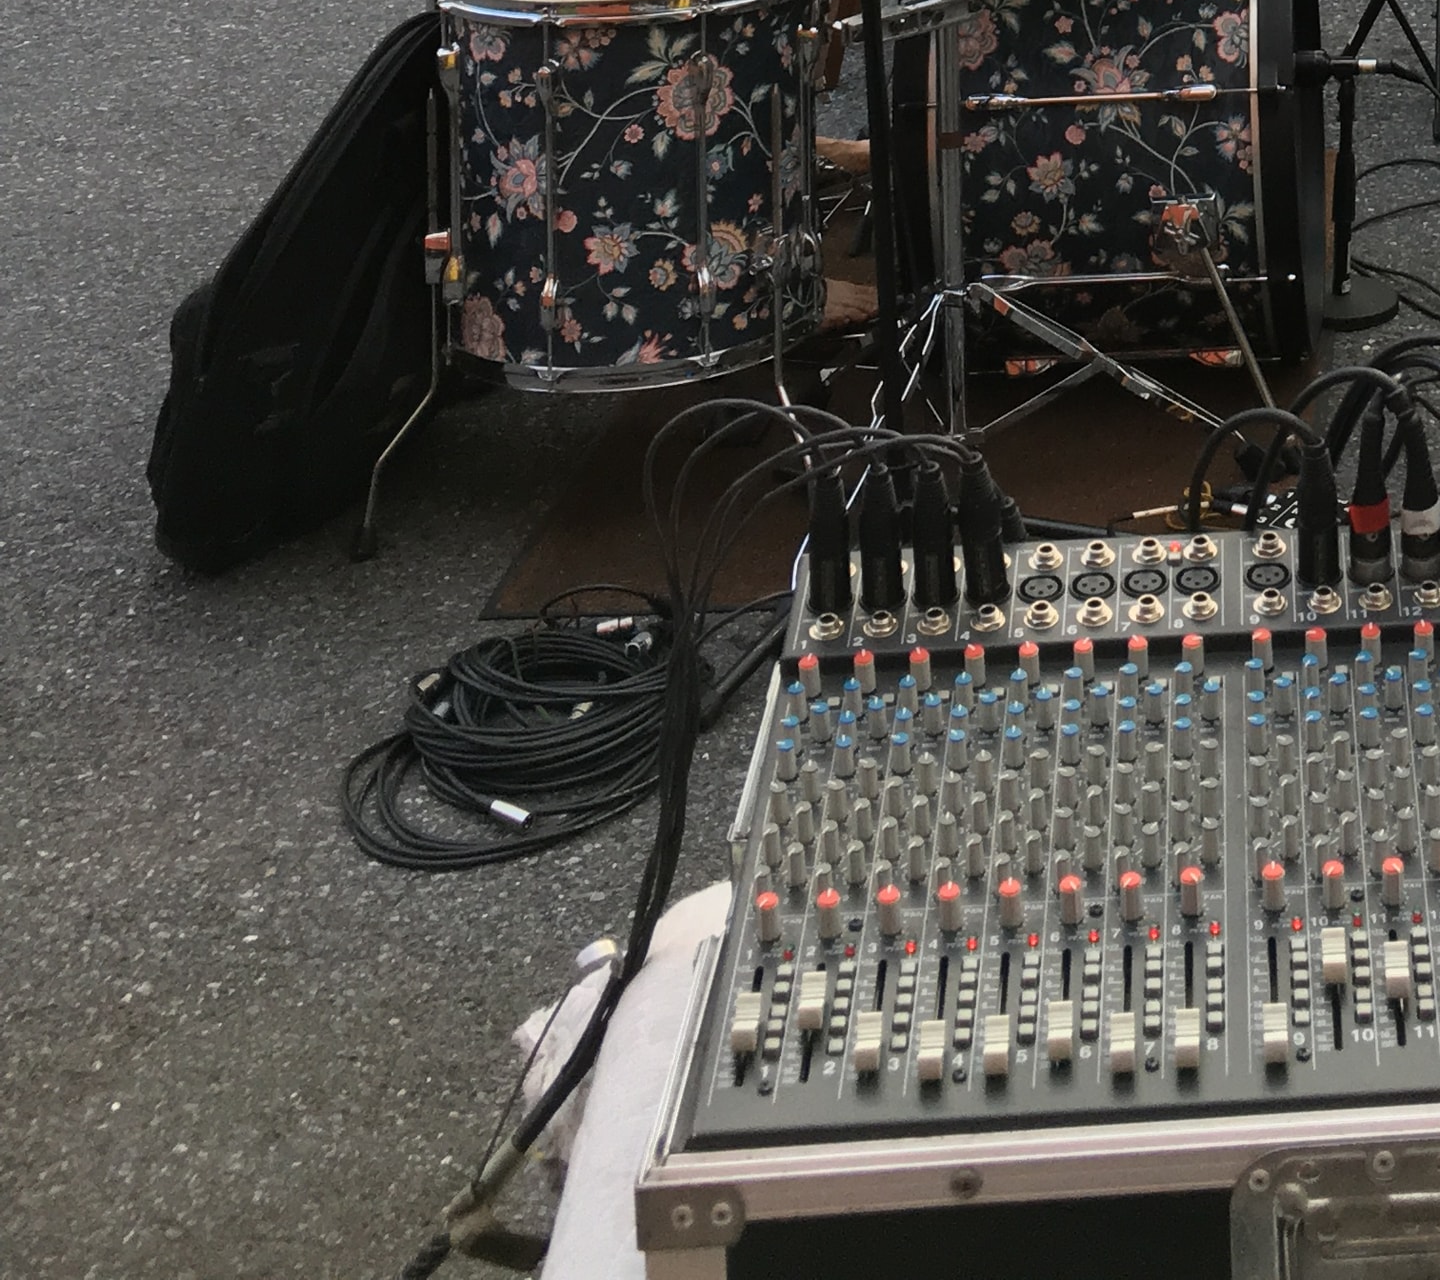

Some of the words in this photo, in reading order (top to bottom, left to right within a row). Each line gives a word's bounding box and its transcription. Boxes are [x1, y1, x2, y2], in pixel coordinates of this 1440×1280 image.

[801, 640, 807, 650] 1
[852, 636, 864, 647] 2
[906, 633, 917, 644] 3
[960, 631, 971, 641] 4
[1013, 627, 1024, 638] 5
[1067, 624, 1078, 635] 6
[1121, 621, 1131, 632] 7
[1173, 618, 1184, 629] 8
[1249, 614, 1261, 625] 9
[1297, 612, 1317, 622] 10
[1350, 609, 1368, 619] 11
[1402, 606, 1423, 617] 12
[746, 949, 753, 960] 1
[806, 945, 817, 957] 2
[867, 942, 877, 953] 3
[928, 939, 938, 950] 4
[989, 935, 999, 946] 5
[1050, 931, 1061, 942] 6
[1110, 927, 1121, 938] 7
[1171, 924, 1182, 936] 8
[1253, 919, 1264, 931] 9
[1310, 916, 1329, 927] 10
[1369, 913, 1387, 924] 11
[760, 1065, 769, 1079] 1
[822, 1060, 836, 1075] 2
[887, 1057, 900, 1071] 3
[952, 1053, 964, 1067] 4
[1015, 1048, 1028, 1063] 5
[1079, 1045, 1093, 1059] 6
[1143, 1041, 1156, 1056] 7
[1206, 1037, 1219, 1051] 8
[1292, 1031, 1306, 1046] 9
[1351, 1028, 1374, 1042] 10
[1413, 1024, 1435, 1039] 11
